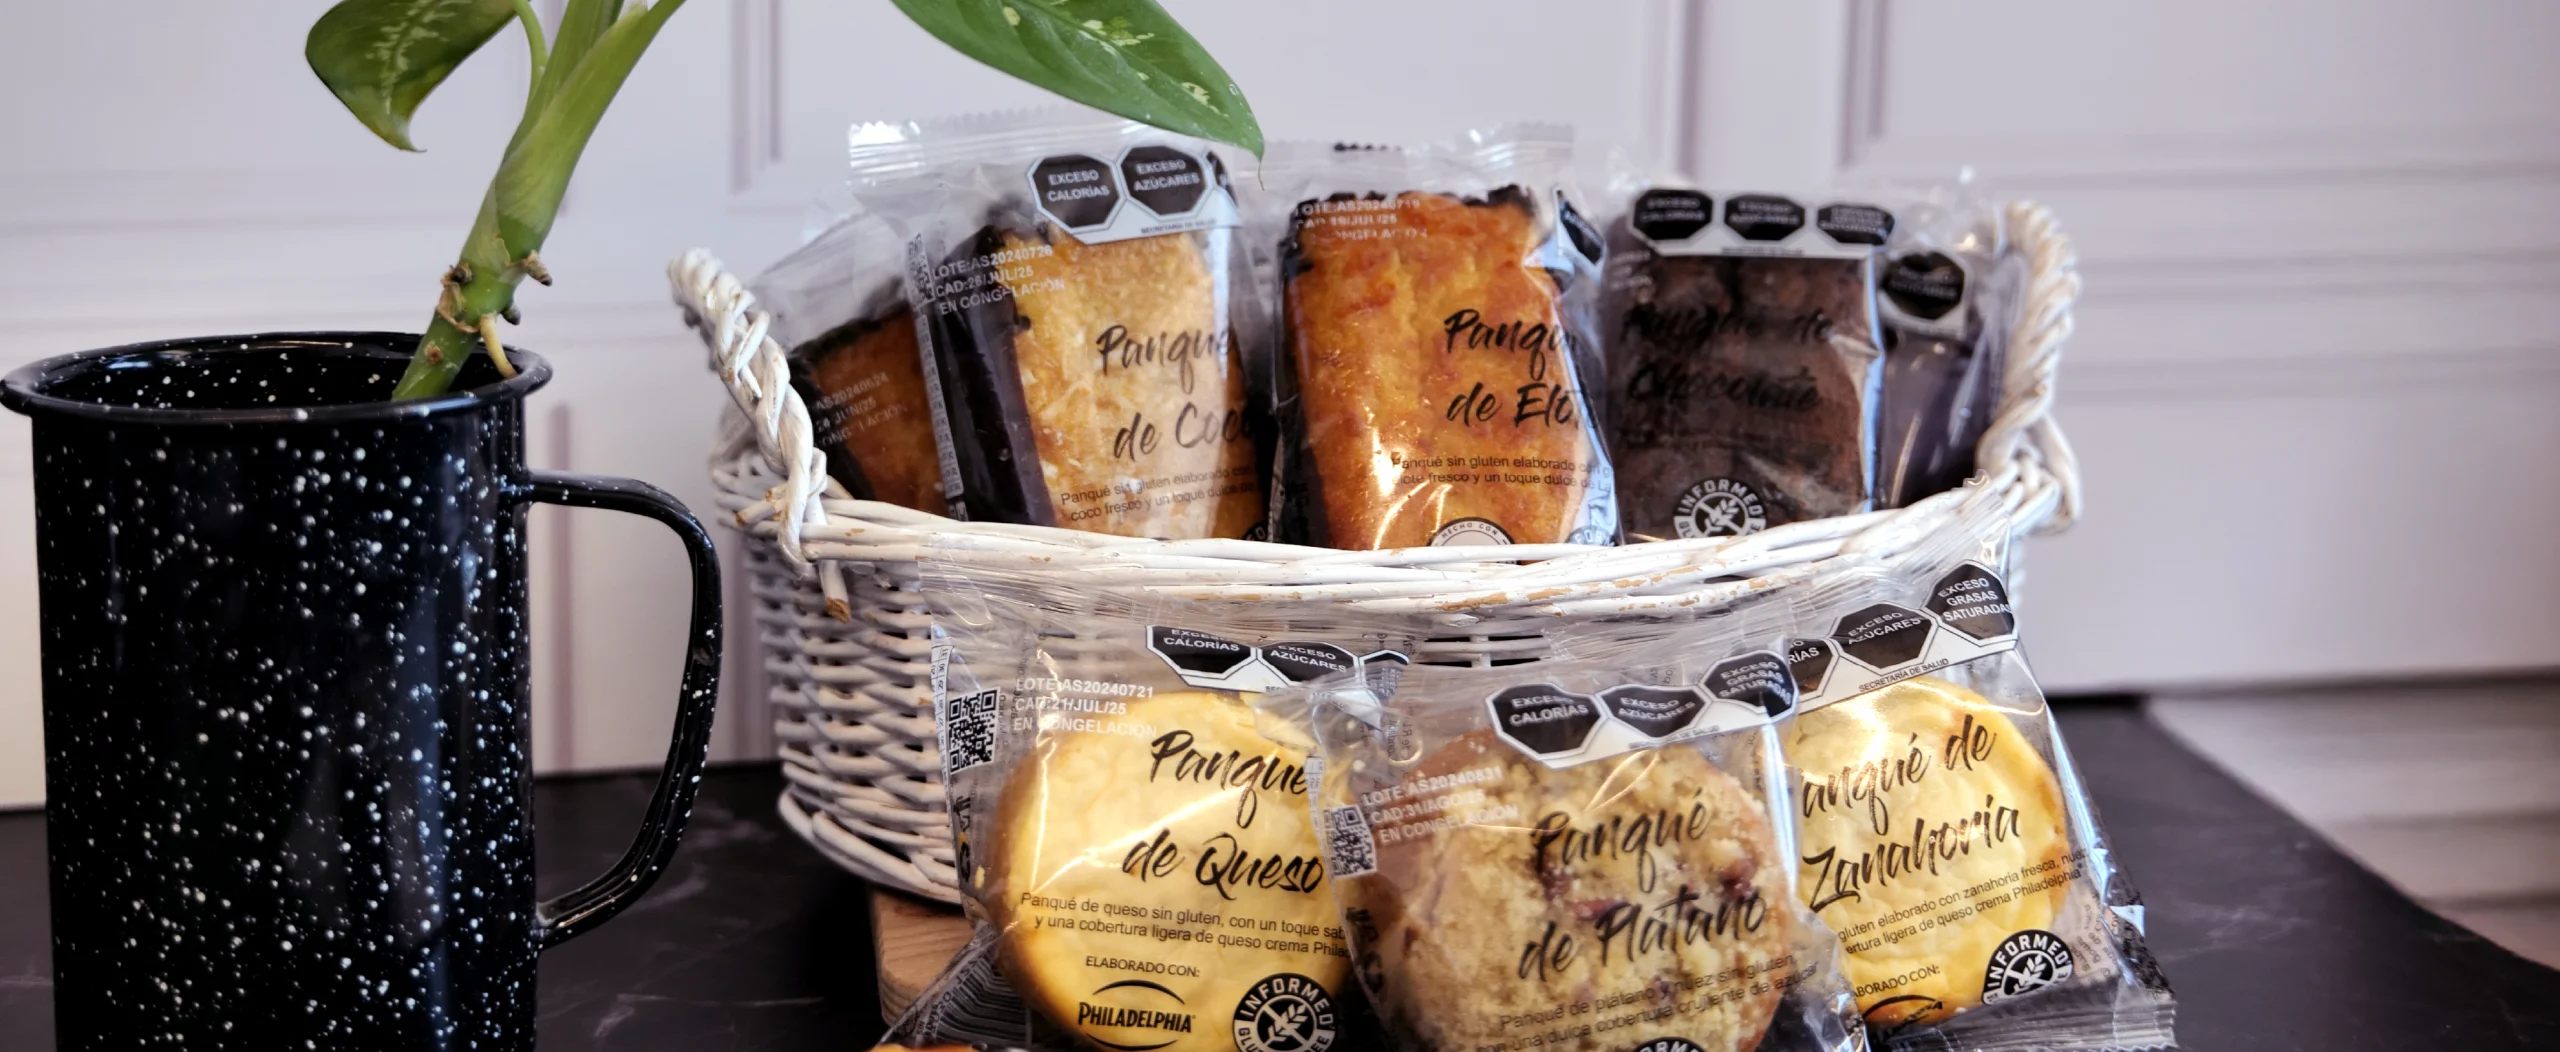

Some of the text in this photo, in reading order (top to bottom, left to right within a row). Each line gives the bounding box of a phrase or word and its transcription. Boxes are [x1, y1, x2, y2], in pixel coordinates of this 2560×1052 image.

[1047, 169, 1099, 186] EXCESO
[1135, 159, 1187, 174] EXCESO
[1046, 184, 1110, 202] CALORÍAS
[1133, 172, 1200, 192] AZÚCARES
[939, 301, 959, 315] EN
[1446, 381, 1503, 428] de
[1113, 412, 1163, 462] de
[1446, 455, 1466, 468] sin
[1469, 455, 1510, 470] gluten
[1513, 456, 1576, 473] elaborado
[1428, 472, 1470, 484] fresco
[1484, 473, 1500, 484] un
[1504, 472, 1541, 487] toque
[1543, 473, 1577, 487] dulce
[1677, 478, 1765, 516] INFORMED
[1070, 507, 1101, 522] coco
[1104, 500, 1143, 515] fresco
[1440, 522, 1499, 539] HECHO CON
[1937, 577, 1990, 598] EXCESO
[1946, 589, 1999, 608] GRASAS
[1848, 611, 1904, 637] EXCESO
[1163, 636, 1241, 652] CALORÍAS
[1269, 650, 1348, 674] AZÚCARES
[1720, 661, 1781, 679] EXCESO
[1910, 666, 1922, 676] DE
[1922, 658, 1949, 672] SALUD
[1015, 677, 1154, 699] LOTEAS20240721
[1509, 703, 1589, 726] CALORÍAS
[1617, 700, 1696, 720] AZÚCARES
[1619, 697, 1680, 709] EXCESO
[1013, 717, 1033, 731] EN
[1802, 713, 1997, 836] anqué de
[1379, 826, 1401, 844] EN
[1530, 788, 1713, 894] Panqué
[1122, 827, 1325, 901] de Queso
[1802, 794, 2021, 914] Zanahoria
[1020, 891, 1077, 912] Panqué
[1081, 898, 1100, 912] de
[1103, 903, 1148, 918] queso
[1151, 906, 1173, 920] sin
[1176, 909, 1224, 928] gluten,
[1229, 916, 1255, 930] con
[1259, 919, 1277, 932] un
[1281, 920, 1320, 938] toque
[1837, 920, 1875, 943] gluten
[1878, 901, 1937, 928] elaborado
[1938, 892, 1961, 908] con
[1962, 872, 2020, 898] zanahoria
[1034, 915, 1044, 929] y
[1047, 916, 1075, 929] una
[1079, 919, 1148, 937] cobertura
[1151, 924, 1192, 942] ligera
[1195, 930, 1214, 944] de
[1217, 933, 1262, 949] queso
[1265, 939, 1309, 953] crema
[1845, 937, 1881, 954] ertura
[1882, 924, 1917, 946] ligera
[1919, 918, 1935, 931] de
[1937, 906, 1973, 927] queso
[1974, 894, 2012, 913] crema
[1517, 920, 1577, 982] de
[1987, 933, 2071, 988] INFORMED
[1086, 955, 1200, 978] ELABORADO CON:
[1750, 980, 1770, 995] de
[1852, 963, 1941, 998] ABORADO CON:
[1239, 977, 1335, 1026] INFORMED
[1569, 1001, 1590, 1016] de
[1673, 974, 1713, 991] nuez
[1078, 1001, 1193, 1034] PHILADELPHIA
